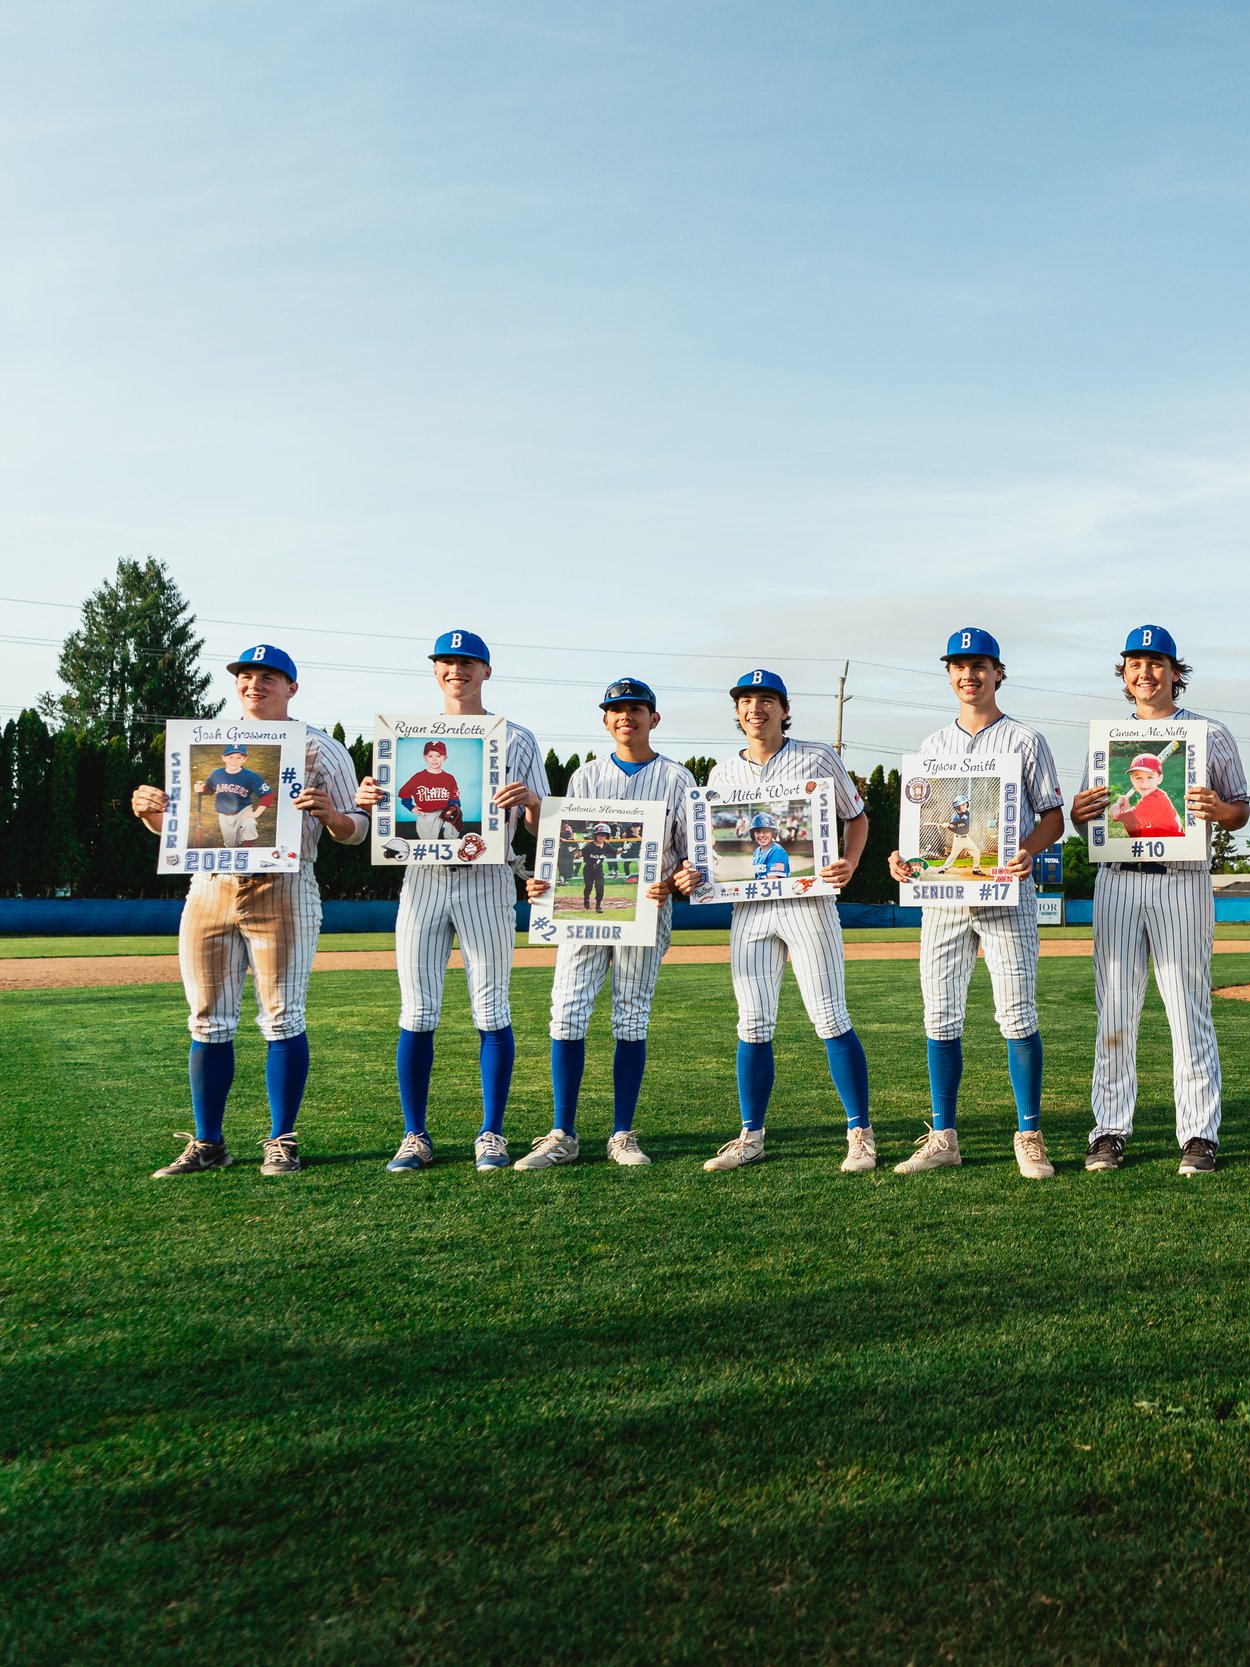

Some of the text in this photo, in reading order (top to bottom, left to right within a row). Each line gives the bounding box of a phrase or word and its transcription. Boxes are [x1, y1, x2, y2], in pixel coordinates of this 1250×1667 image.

[451, 633, 462, 648] B
[961, 633, 971, 649] B
[1142, 630, 1152, 646] B
[252, 647, 266, 661] B
[752, 671, 763, 684] B
[193, 726, 287, 742] Josh Grossman
[396, 721, 485, 737] Ryan Brulotte
[1109, 728, 1140, 738] Carson
[923, 758, 996, 775] Tyson Smith
[1186, 744, 1197, 826] SENR
[166, 752, 181, 848] SENIOR
[722, 784, 801, 804] Mitch Wort
[1093, 751, 1106, 846] 205
[561, 803, 645, 816] Antonio Hernandez
[819, 793, 831, 869] SENIO
[413, 843, 453, 861] #43
[1131, 841, 1165, 857] #10
[184, 850, 249, 872] 2025
[745, 881, 783, 899] #34
[913, 883, 1010, 900] SENIOR #17
[532, 916, 557, 942] #2
[566, 925, 622, 940] SENIOR
